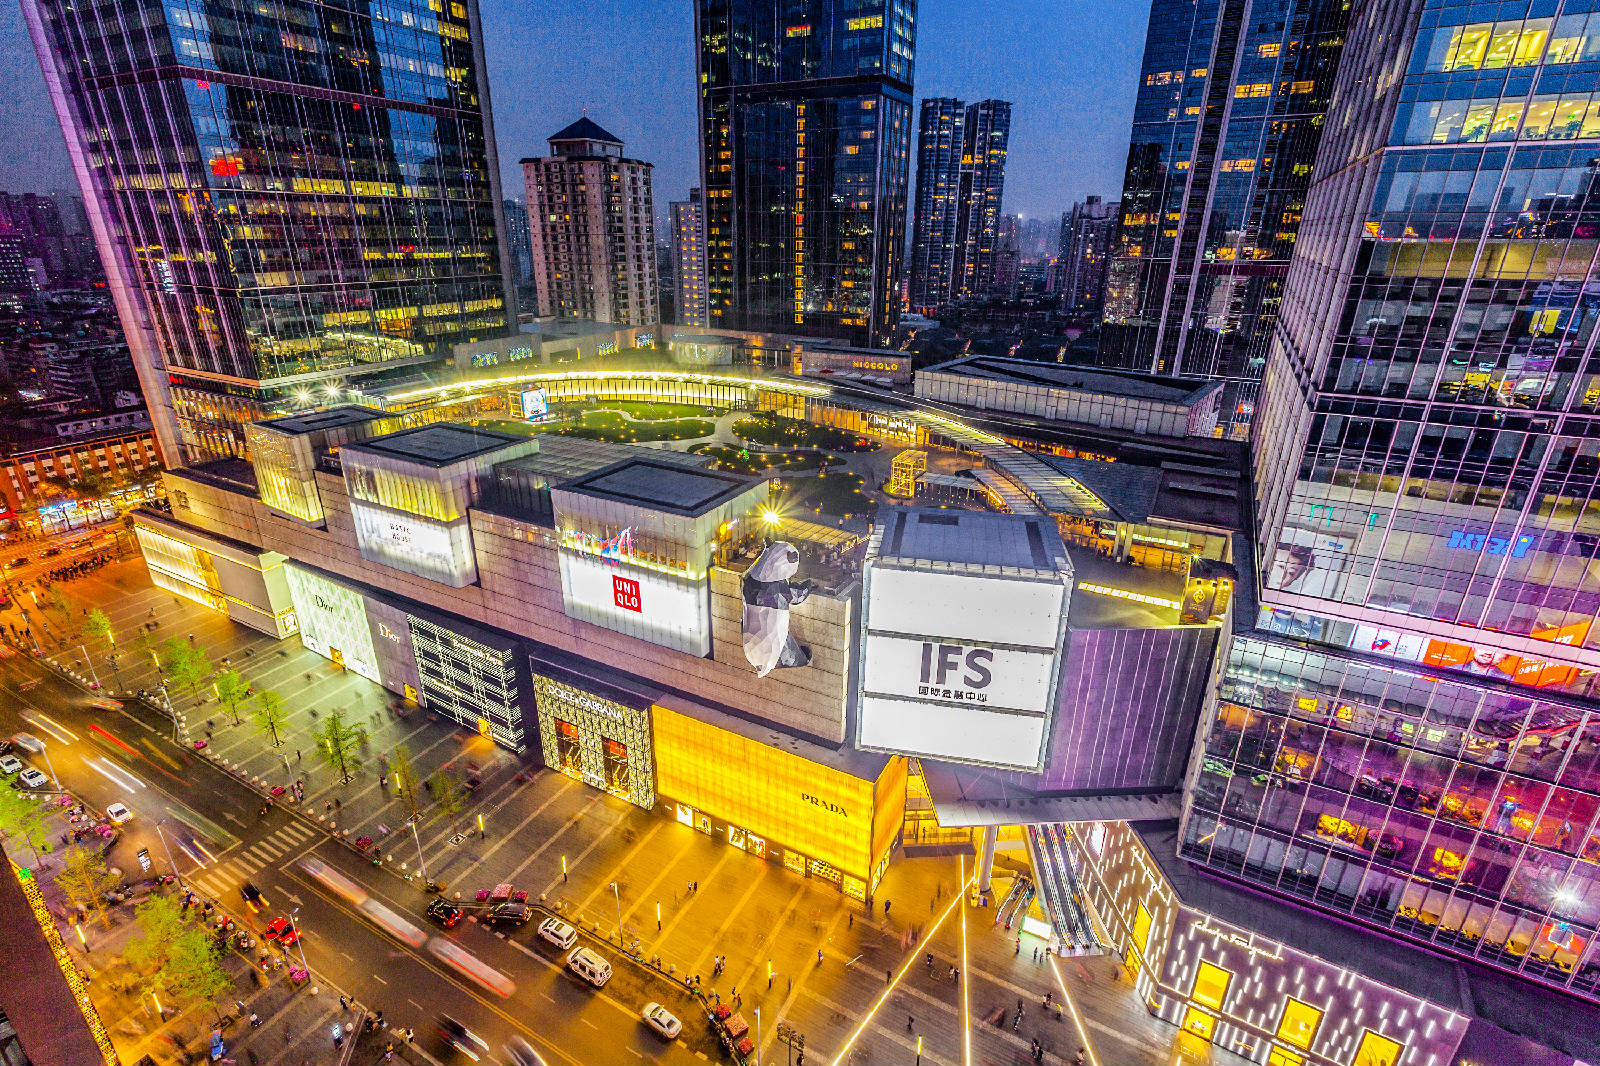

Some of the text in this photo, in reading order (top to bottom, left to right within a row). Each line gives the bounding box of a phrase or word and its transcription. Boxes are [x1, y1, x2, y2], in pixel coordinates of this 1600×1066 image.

[852, 360, 898, 370] NICCOLO
[615, 579, 636, 596] UNI
[315, 594, 333, 613] Dior
[617, 592, 638, 608] QLO
[378, 622, 400, 643] Dior
[920, 642, 994, 690] IFS
[918, 685, 988, 702] 国际金融中心
[801, 792, 848, 818] PRADA
